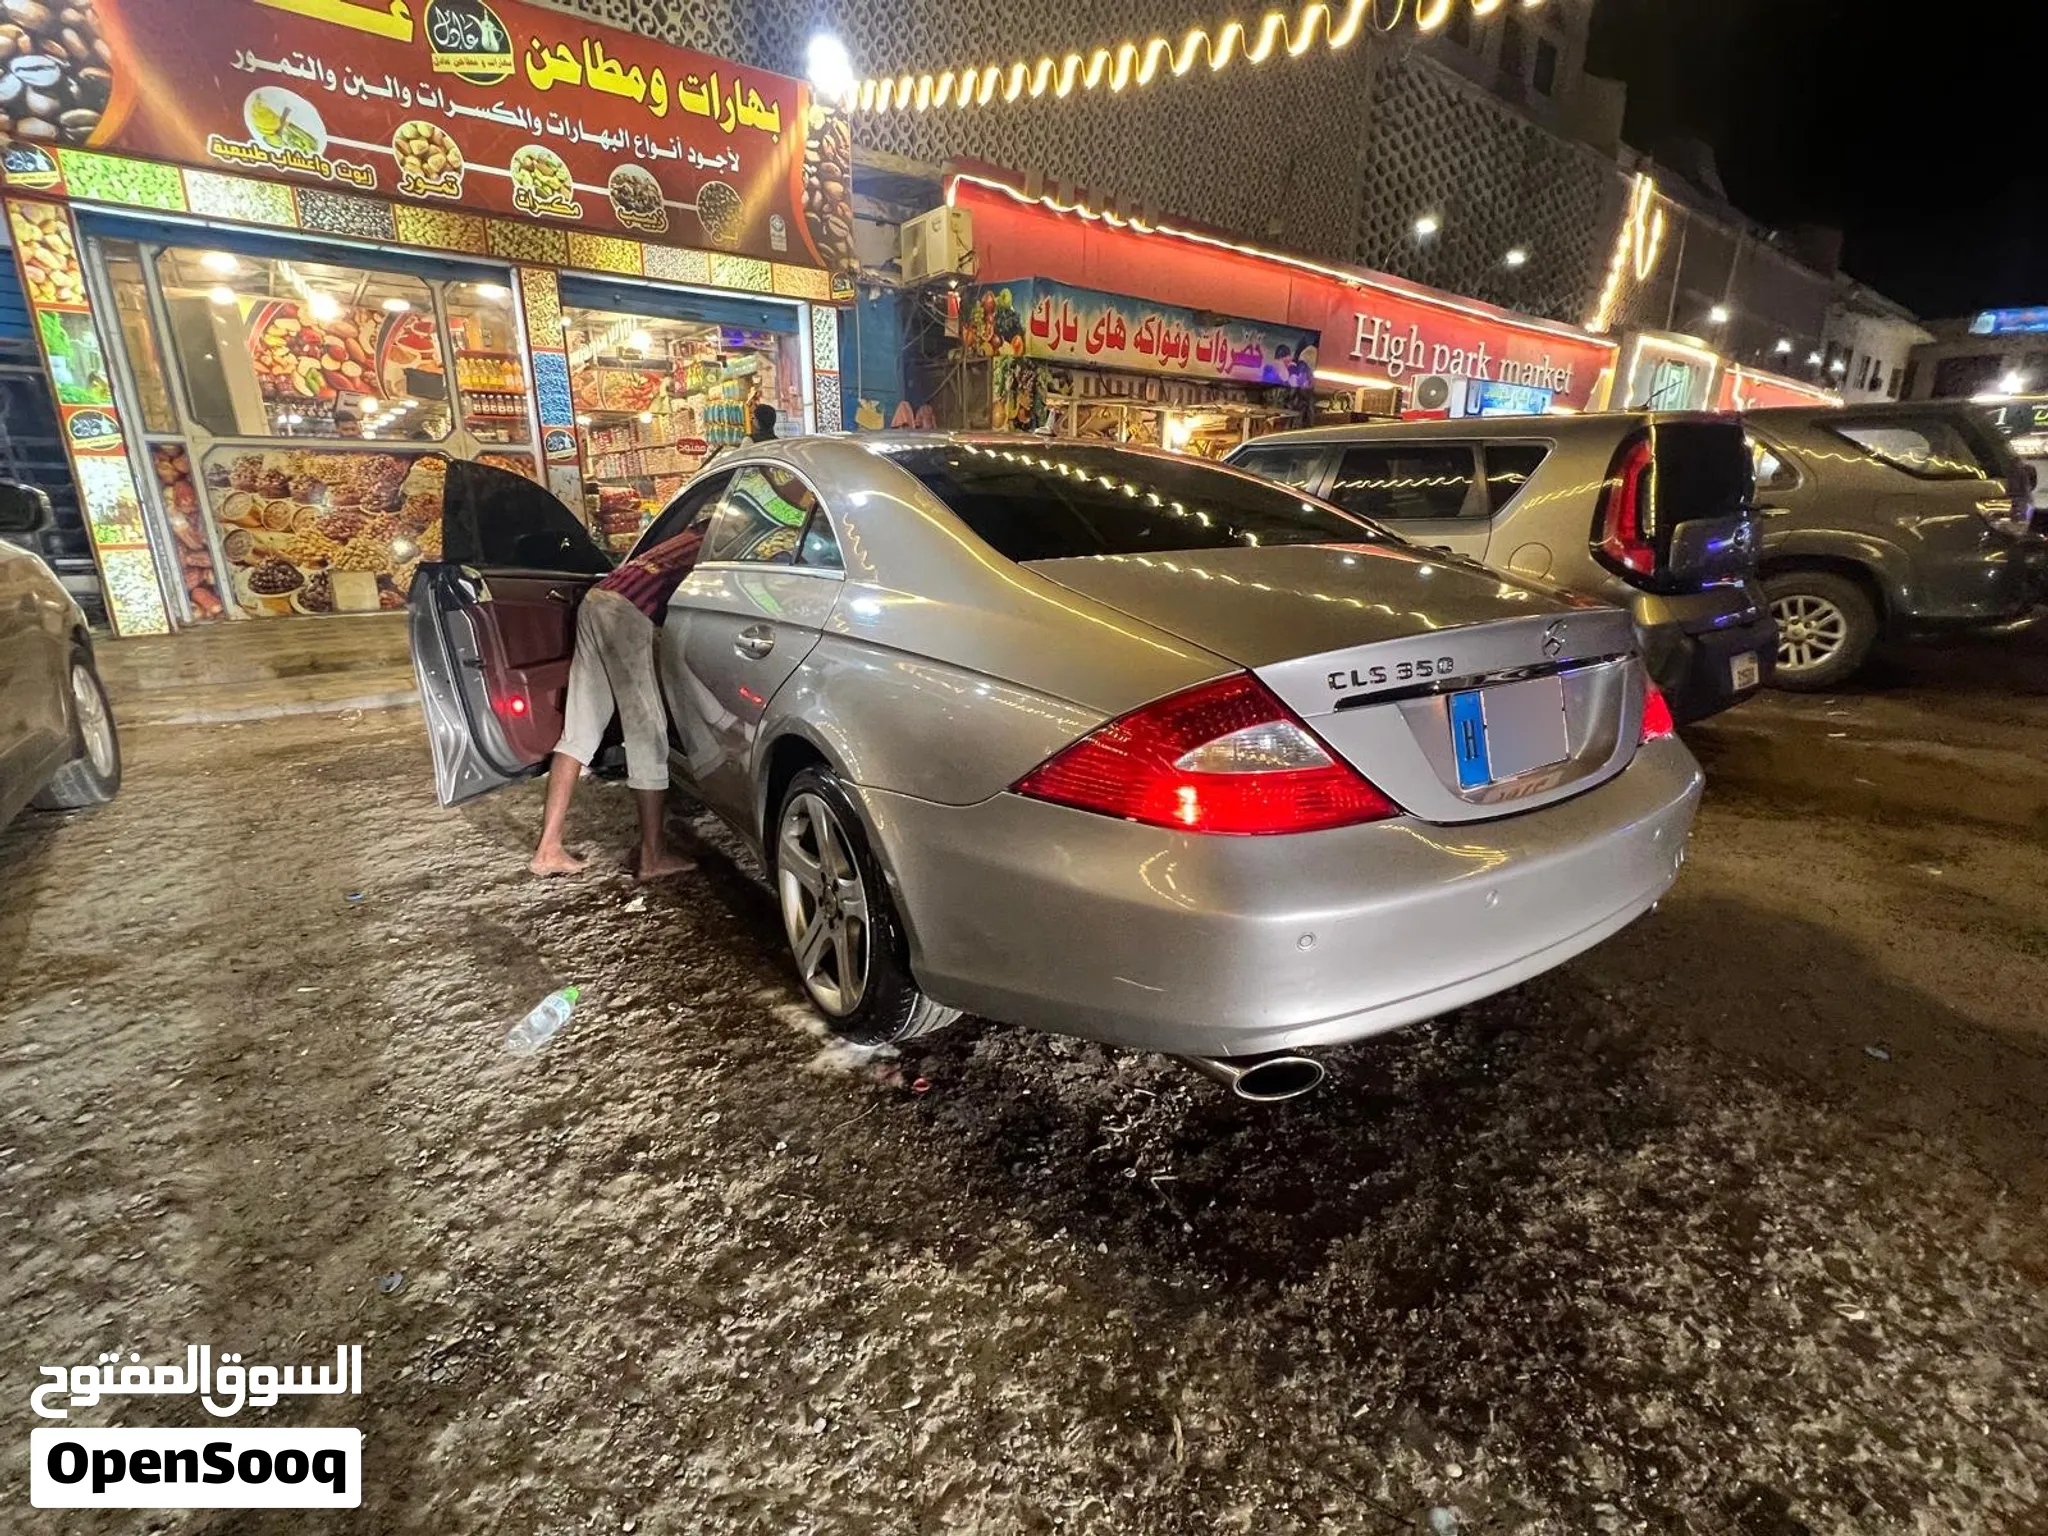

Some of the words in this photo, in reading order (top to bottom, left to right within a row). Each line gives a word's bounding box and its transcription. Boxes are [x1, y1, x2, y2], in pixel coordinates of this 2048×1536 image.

[230, 49, 337, 91] والتمور
[343, 66, 412, 109] والبن
[525, 36, 668, 117] ومطاحن
[416, 82, 543, 136] والمكسرات
[678, 72, 781, 143] بهارات
[210, 137, 269, 164] طبيعية
[546, 112, 629, 151] البهارات
[634, 136, 682, 159] أنواع
[335, 161, 374, 187] زيوت
[688, 146, 739, 174] لأجود
[401, 174, 460, 197] تمور
[514, 188, 581, 217] مكسرات
[1030, 297, 1078, 352] بارك
[1134, 315, 1190, 368] وفواكه
[1196, 328, 1263, 375] خضروات
[1350, 313, 1425, 377] High
[1432, 341, 1492, 379] park
[1499, 355, 1573, 394] market
[1327, 666, 1387, 690] CLS
[1396, 657, 1454, 680] 350
